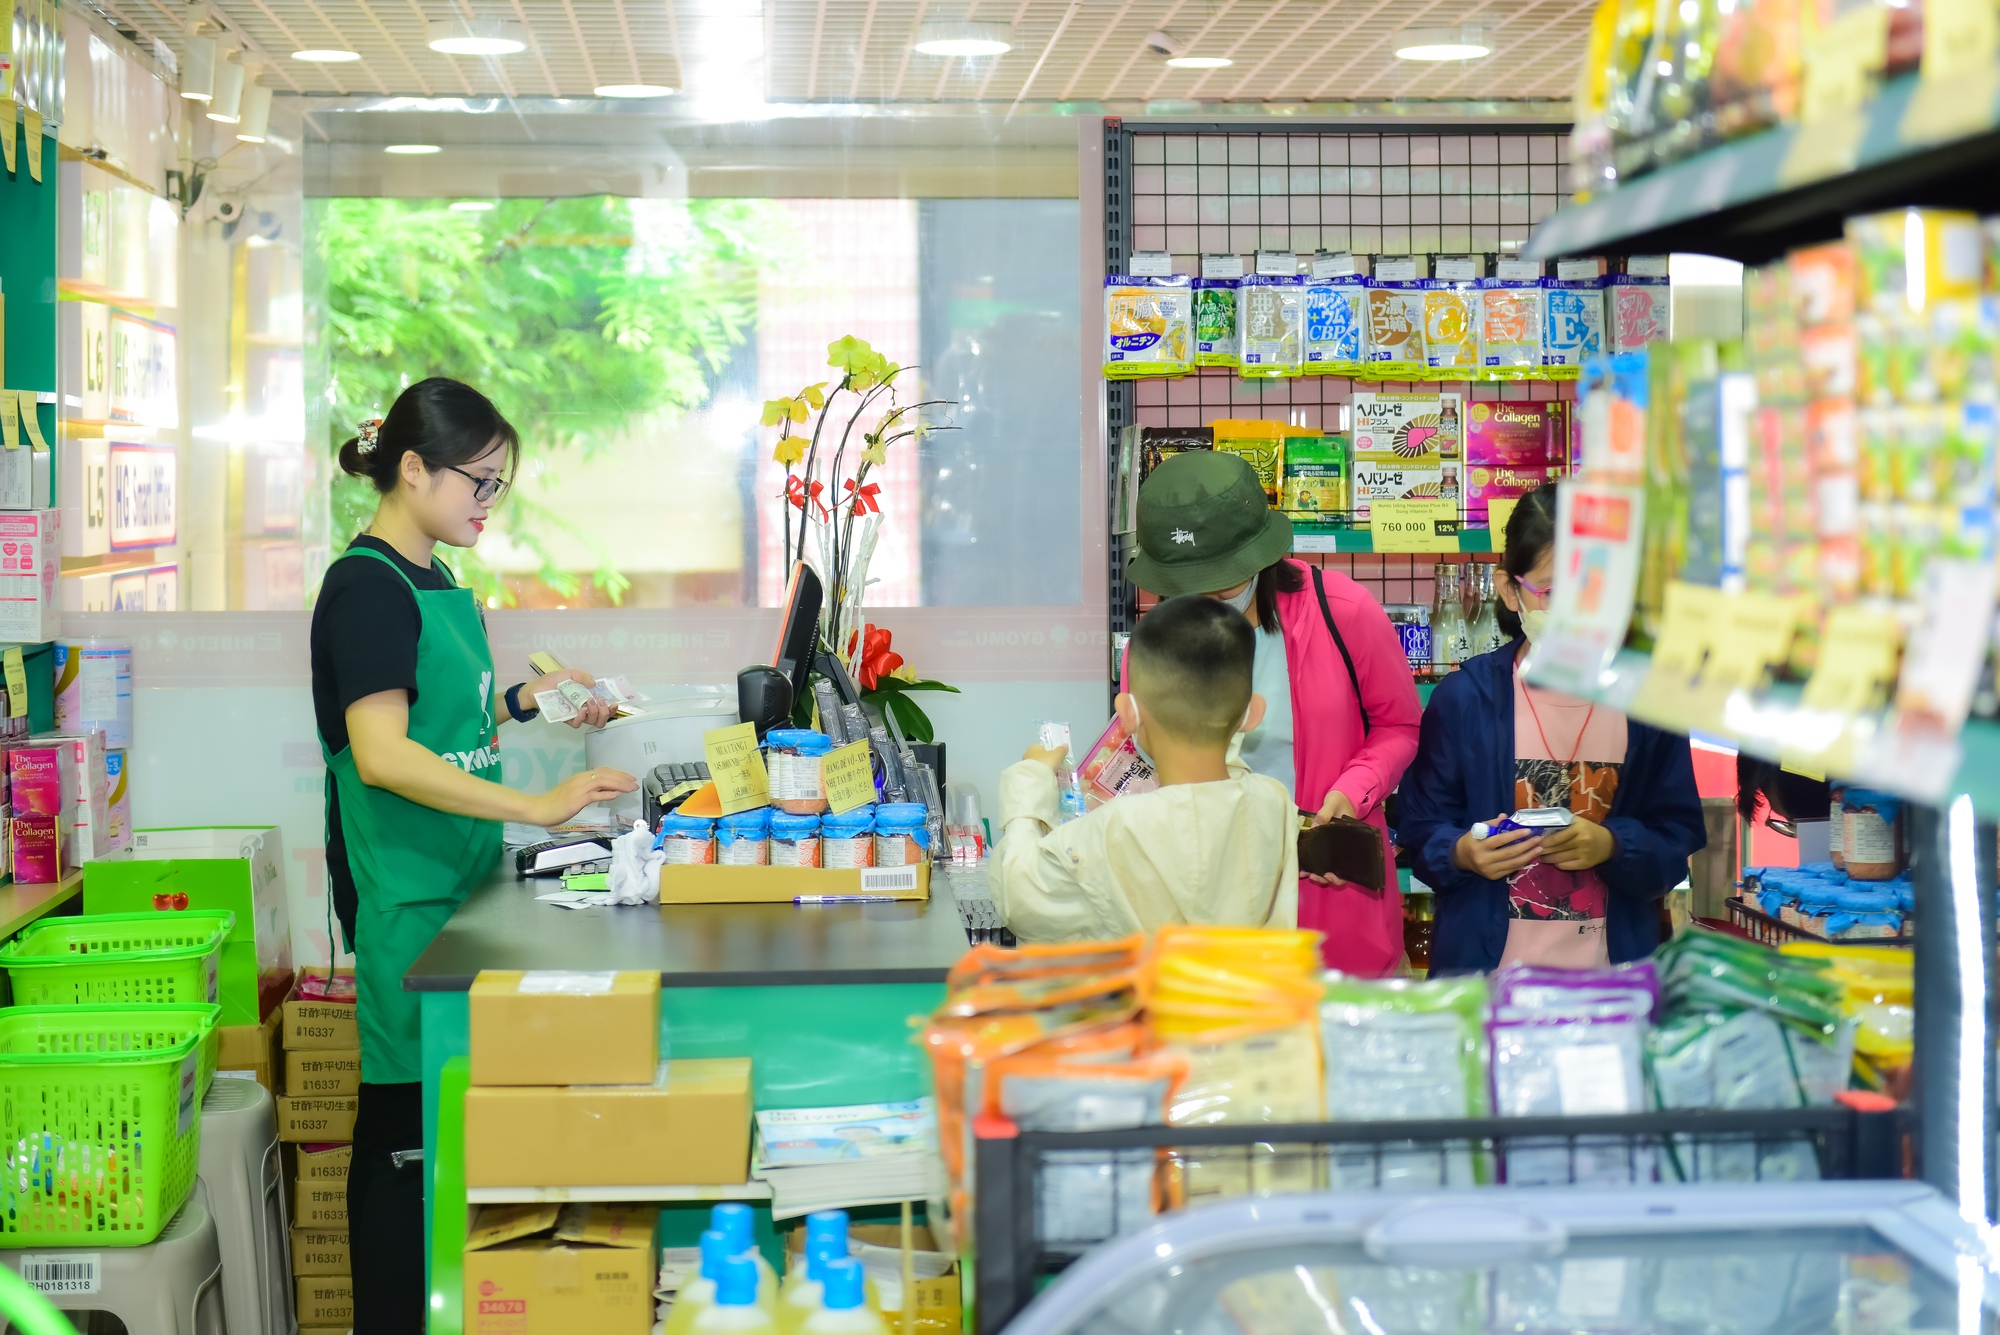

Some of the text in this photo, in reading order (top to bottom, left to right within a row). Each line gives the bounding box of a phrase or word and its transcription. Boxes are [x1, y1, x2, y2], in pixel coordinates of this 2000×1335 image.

[1110, 276, 1133, 284] DHC
[1246, 276, 1269, 285] DHC
[1368, 279, 1389, 287] DHC
[1483, 280, 1505, 288] DHC
[1548, 280, 1567, 288] DHC
[1617, 276, 1637, 284] DHC
[1552, 295, 1577, 308] 天然
[1250, 292, 1275, 337] 亜鉛
[1386, 296, 1408, 332] 濃縮
[1372, 300, 1392, 344] ウコン
[1428, 306, 1463, 340] C
[1310, 325, 1346, 340] CBP
[1551, 312, 1582, 345] E
[1115, 335, 1155, 349] オルニチン
[87, 328, 103, 392] L6
[1357, 403, 1402, 417] ヘパリーゼ
[1494, 403, 1514, 412] The
[1494, 412, 1540, 424] Collagen
[1494, 468, 1514, 477] The
[1358, 472, 1403, 485] ヘパリーゼ
[1494, 477, 1540, 489] Collagen
[88, 465, 104, 528] L5
[116, 464, 129, 528] HG
[1381, 522, 1426, 532] 760 000
[1407, 628, 1428, 640] One
[14, 762, 54, 772] Collagen
[826, 763, 840, 774] HÀNG
[857, 752, 866, 762] XIN
[837, 774, 847, 786] TAY
[16, 820, 32, 829] The
[16, 828, 54, 840] Collagen
[298, 1007, 356, 1020] 甘酢平切生
[304, 1027, 334, 1038] 16337
[310, 1080, 340, 1090] 16337
[290, 1100, 357, 1112] 甘酢平切生姜
[296, 1120, 328, 1130] 16337
[317, 1166, 348, 1177] 16337
[311, 1191, 347, 1202] 甘酢平
[318, 1210, 349, 1220] 16337
[306, 1234, 350, 1245] 甘酢平切
[312, 1254, 343, 1264] 16337
[28, 1280, 91, 1291] RH0181318
[482, 1302, 524, 1312] 34678
[320, 1308, 352, 1318] 16337
